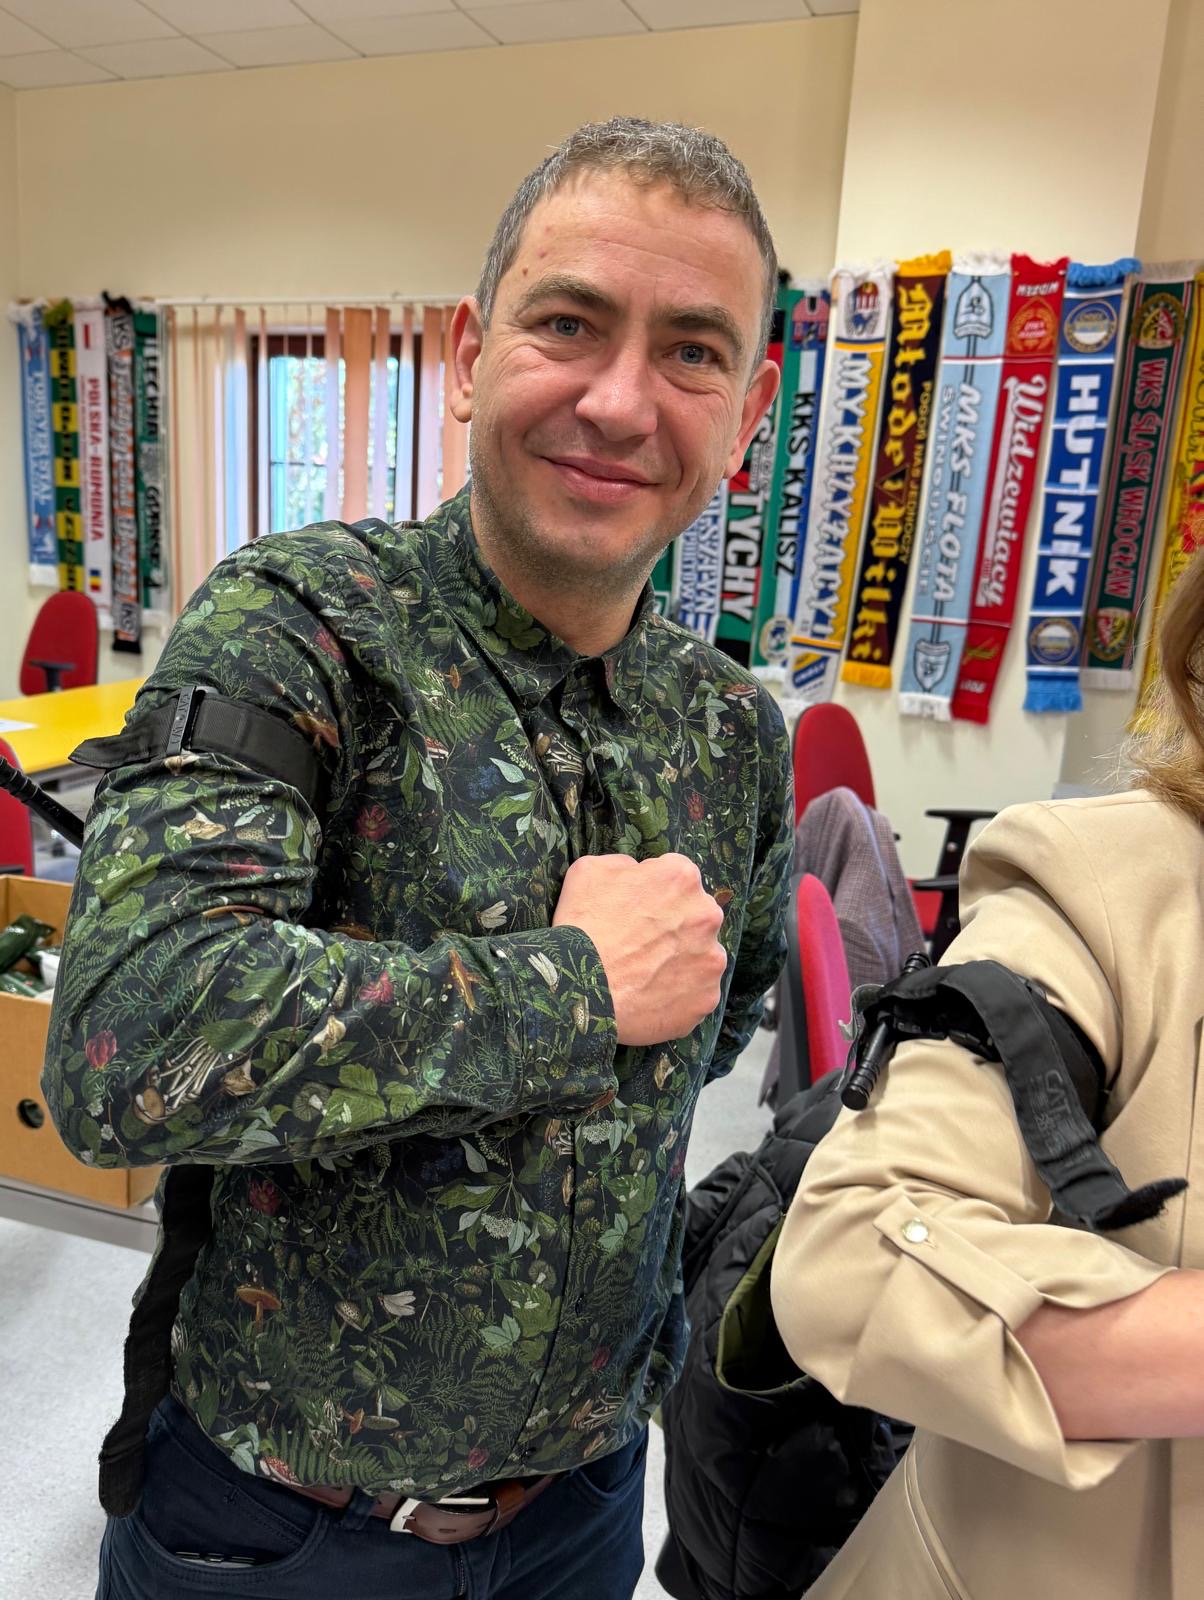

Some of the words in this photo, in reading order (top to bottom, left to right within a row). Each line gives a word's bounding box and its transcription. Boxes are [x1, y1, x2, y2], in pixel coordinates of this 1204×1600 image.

[789, 392, 815, 456] KKS
[836, 357, 872, 417] MY
[885, 285, 931, 467] Młode
[949, 384, 982, 476] MKS
[1131, 357, 1168, 411] WKS
[910, 444, 925, 479] NAS
[976, 375, 1045, 607] Widzewiacy
[1047, 374, 1102, 596] HUTNIK
[1118, 412, 1160, 484] ŚLĄSK
[721, 491, 765, 622] TYCHY
[774, 468, 808, 579] KALISZ
[898, 479, 919, 565] JEDNOCZY
[934, 493, 966, 601] FLOTA
[1101, 487, 1146, 598] WROCŁAW
[852, 503, 904, 660] Wilki
